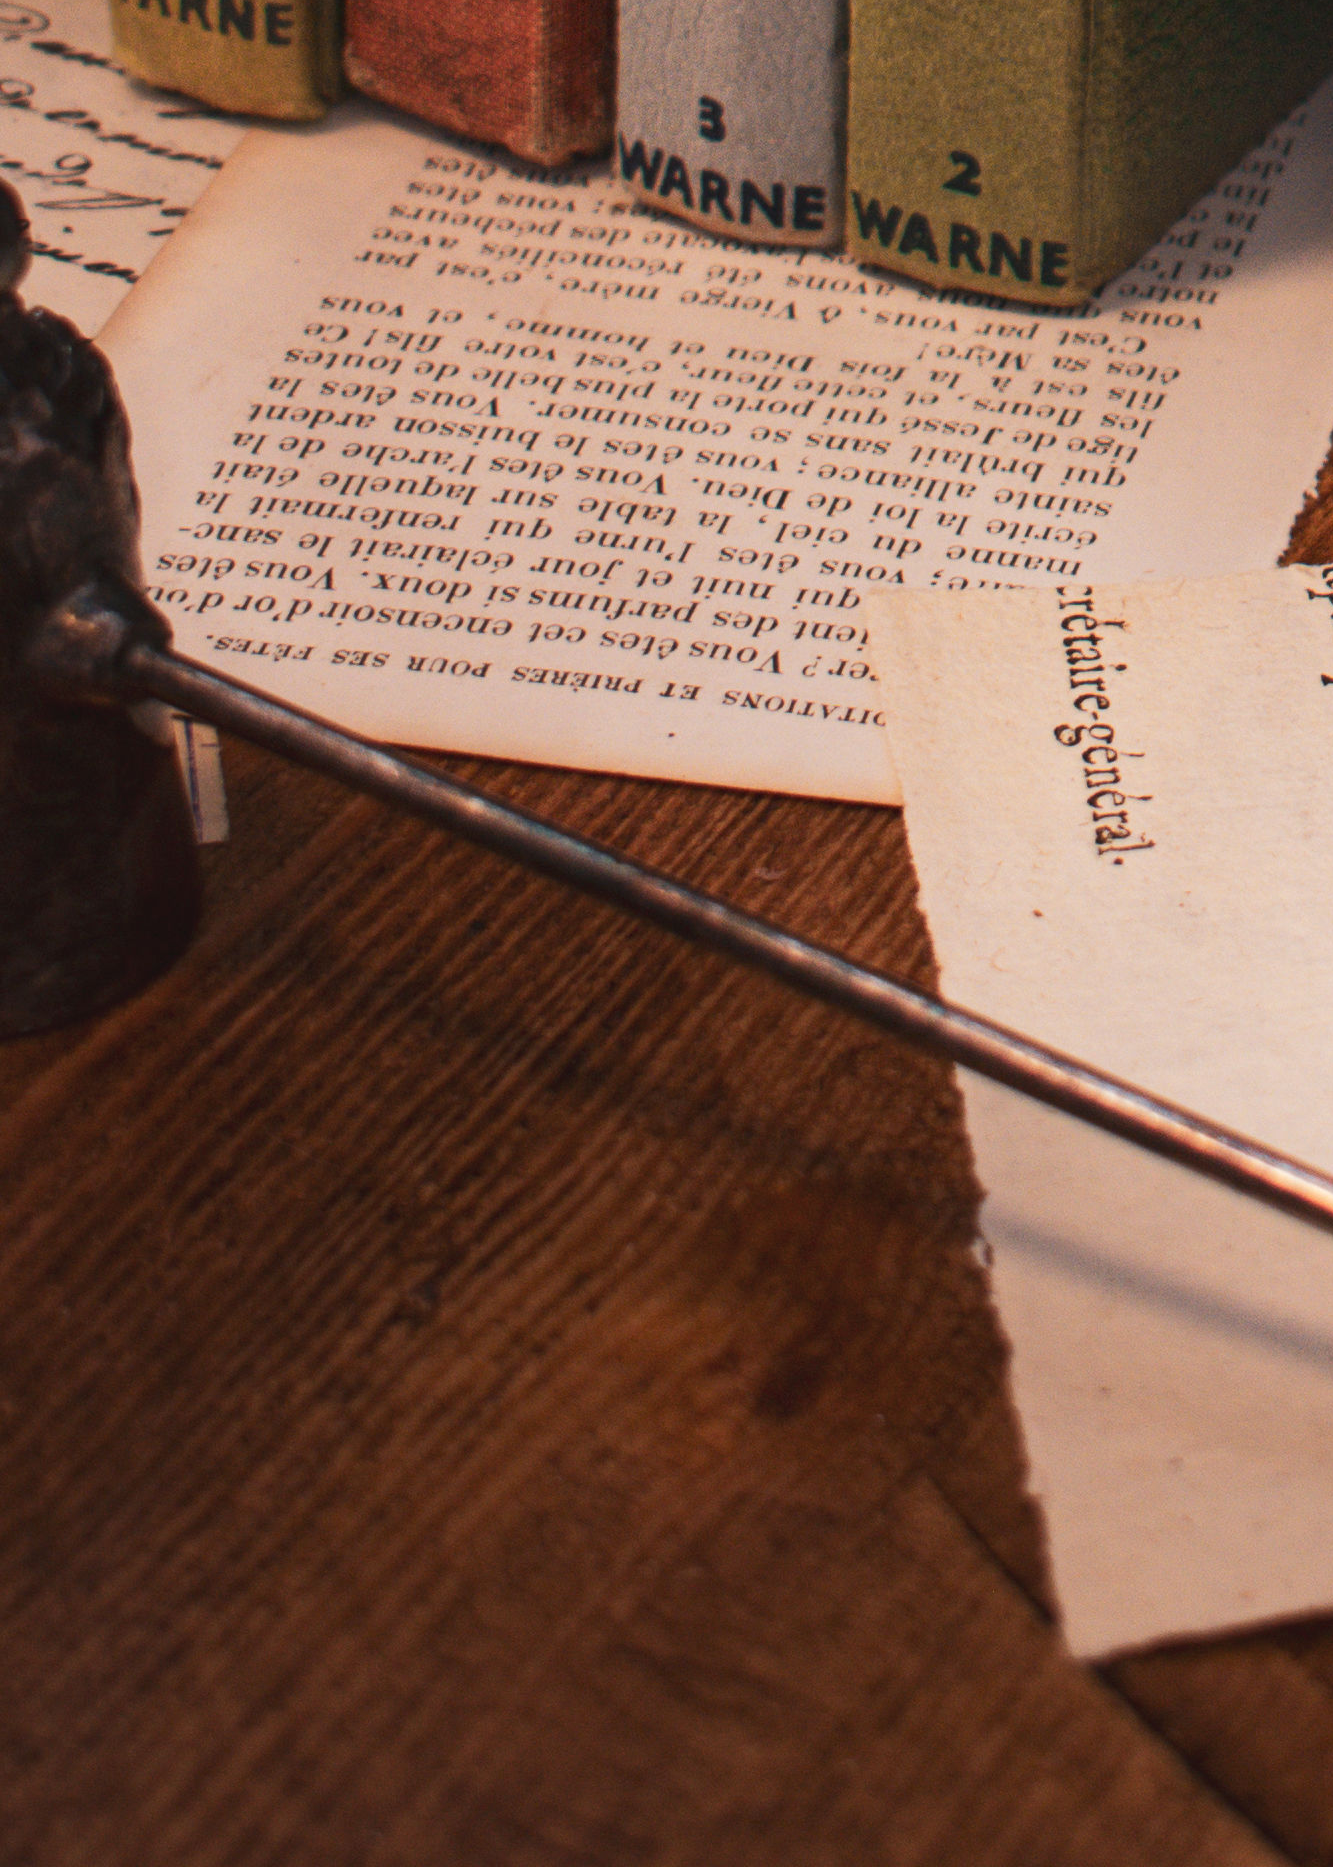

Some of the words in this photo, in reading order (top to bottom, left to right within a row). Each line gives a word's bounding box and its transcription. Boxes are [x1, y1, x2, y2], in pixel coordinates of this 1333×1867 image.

[697, 95, 727, 142] 3
[619, 131, 827, 233] WARNE
[943, 150, 983, 196] 2
[852, 187, 1073, 290] WARNE
[281, 346, 404, 377] toutes
[411, 359, 462, 384] de
[266, 374, 305, 400] la
[317, 378, 399, 408] êtes
[469, 366, 567, 397] belle
[571, 376, 657, 403] plus
[407, 387, 500, 419] Vous
[667, 386, 703, 412] la
[710, 393, 817, 419] porte
[245, 401, 378, 432] ardent
[819, 404, 889, 428] qui
[897, 414, 1006, 447] Jessé
[230, 429, 269, 457] la
[275, 433, 327, 461] de
[391, 414, 542, 454] buisson
[551, 431, 590, 459] le
[747, 424, 794, 445] se
[802, 431, 893, 457] sans
[1009, 429, 1059, 454] de
[339, 440, 479, 477] l'arche
[599, 437, 686, 467] êtes
[692, 448, 780, 474] vous
[907, 443, 1046, 485] brûlait
[1064, 434, 1140, 466] tige
[209, 458, 301, 490] était
[486, 454, 566, 485] êtes
[572, 464, 668, 497] Vous
[794, 454, 979, 504] alliance;
[1057, 463, 1128, 488] qui
[193, 488, 233, 516] la
[316, 469, 480, 508] laquelle
[488, 486, 560, 510] sur
[689, 475, 792, 512] Dieu.
[991, 487, 1114, 520] sainte
[246, 493, 463, 533] renfermait
[575, 494, 678, 529] table
[803, 492, 854, 519] de
[866, 499, 922, 531] loi
[175, 519, 285, 547] sanc-
[481, 515, 554, 543] qui
[696, 508, 734, 537] la
[755, 512, 851, 550] ciel,
[934, 509, 971, 538] la
[983, 517, 1099, 552] écrite
[295, 530, 335, 560] le
[347, 535, 516, 576] éclairait
[571, 527, 697, 565] l'urne
[715, 544, 801, 576] êtes
[870, 532, 924, 561] du
[943, 543, 1083, 578] manne
[153, 551, 237, 583] êtes
[241, 558, 336, 593] Vous
[526, 554, 626, 588] jour
[633, 565, 675, 590] et
[816, 558, 906, 586] vous
[358, 568, 474, 606] doux.
[480, 582, 522, 610] si
[689, 573, 776, 602] nuit
[789, 584, 862, 612] qui
[229, 592, 315, 624] d'or
[315, 598, 515, 638] encensoir
[525, 587, 701, 625] parfums
[526, 620, 588, 645] cet
[709, 608, 781, 640] des
[203, 632, 316, 664] FÊTES.
[328, 646, 392, 669] SES
[596, 628, 681, 662] êtes
[685, 639, 783, 676] Vous
[404, 653, 493, 680] POUR
[508, 664, 645, 696] PRIÈRES
[656, 679, 703, 702] ET
